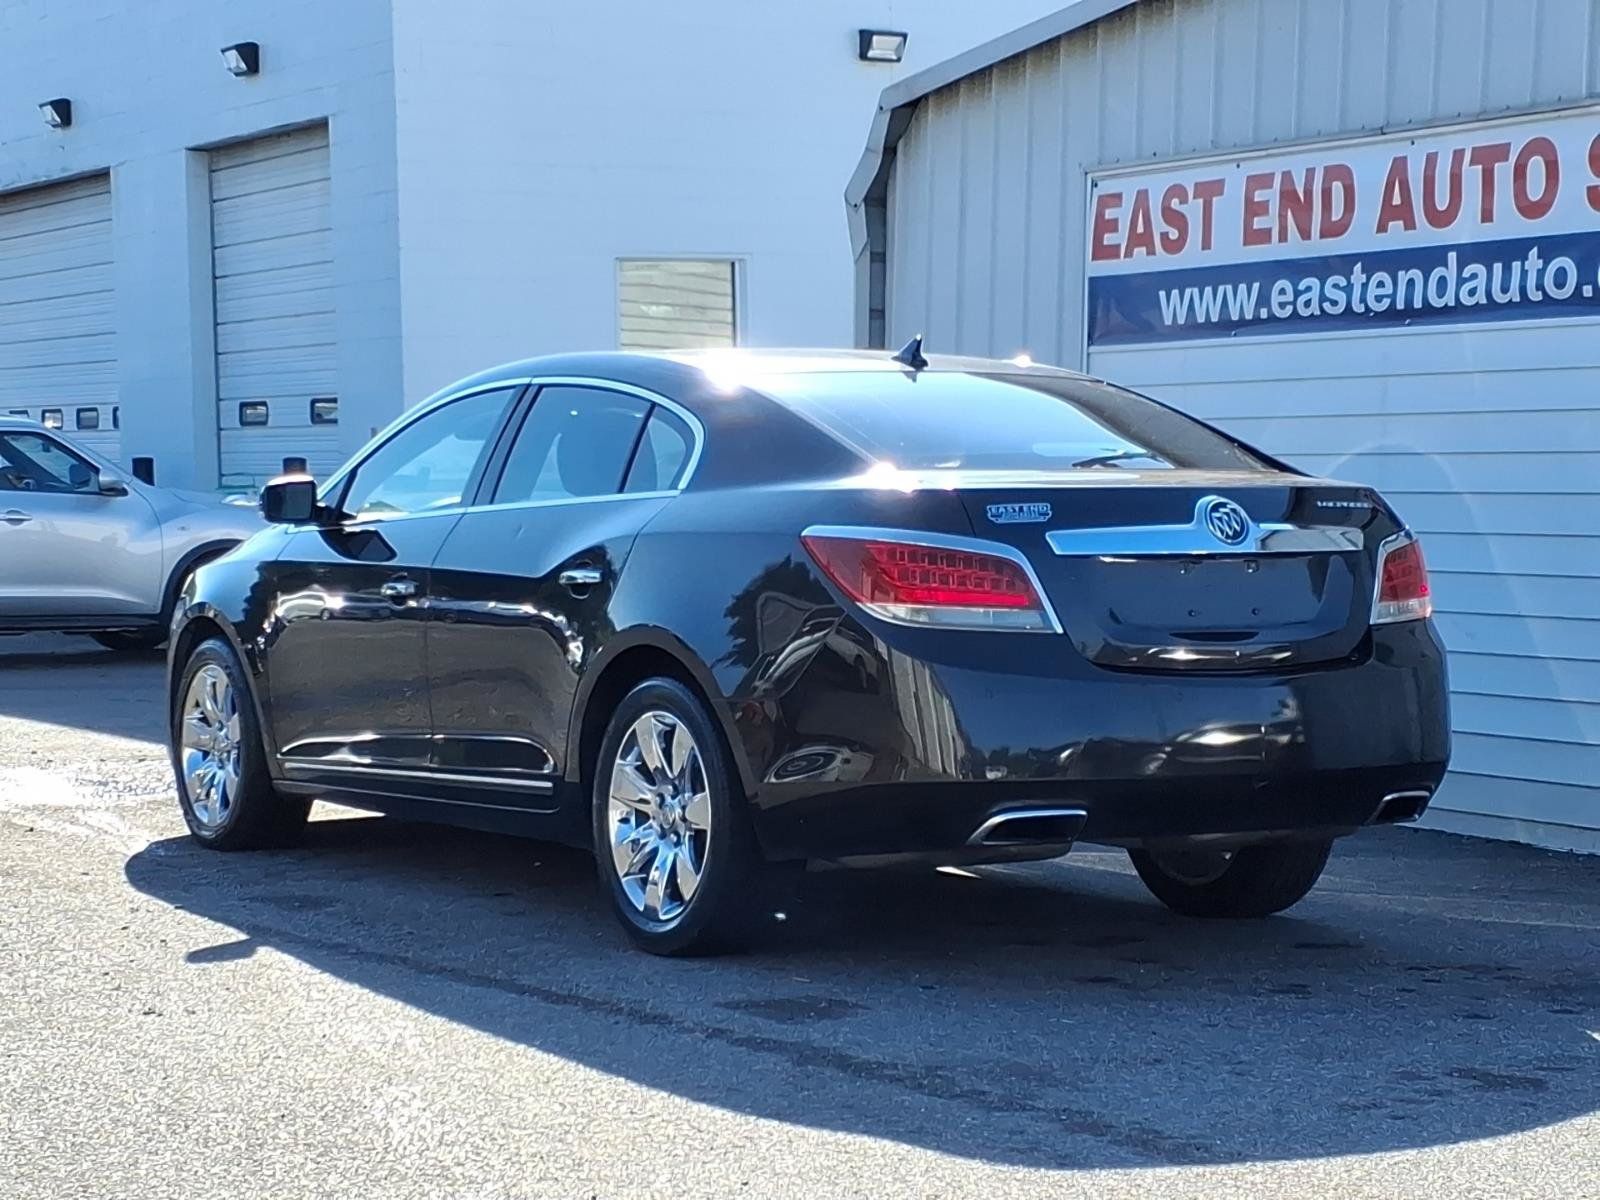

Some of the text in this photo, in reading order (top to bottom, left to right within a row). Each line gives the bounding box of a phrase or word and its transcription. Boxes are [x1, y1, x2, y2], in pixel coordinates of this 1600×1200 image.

[1091, 177, 1225, 262] EAST
[1242, 163, 1355, 247] END
[1376, 136, 1561, 234] AUTO
[1158, 246, 1600, 326] www.eastendauto.
